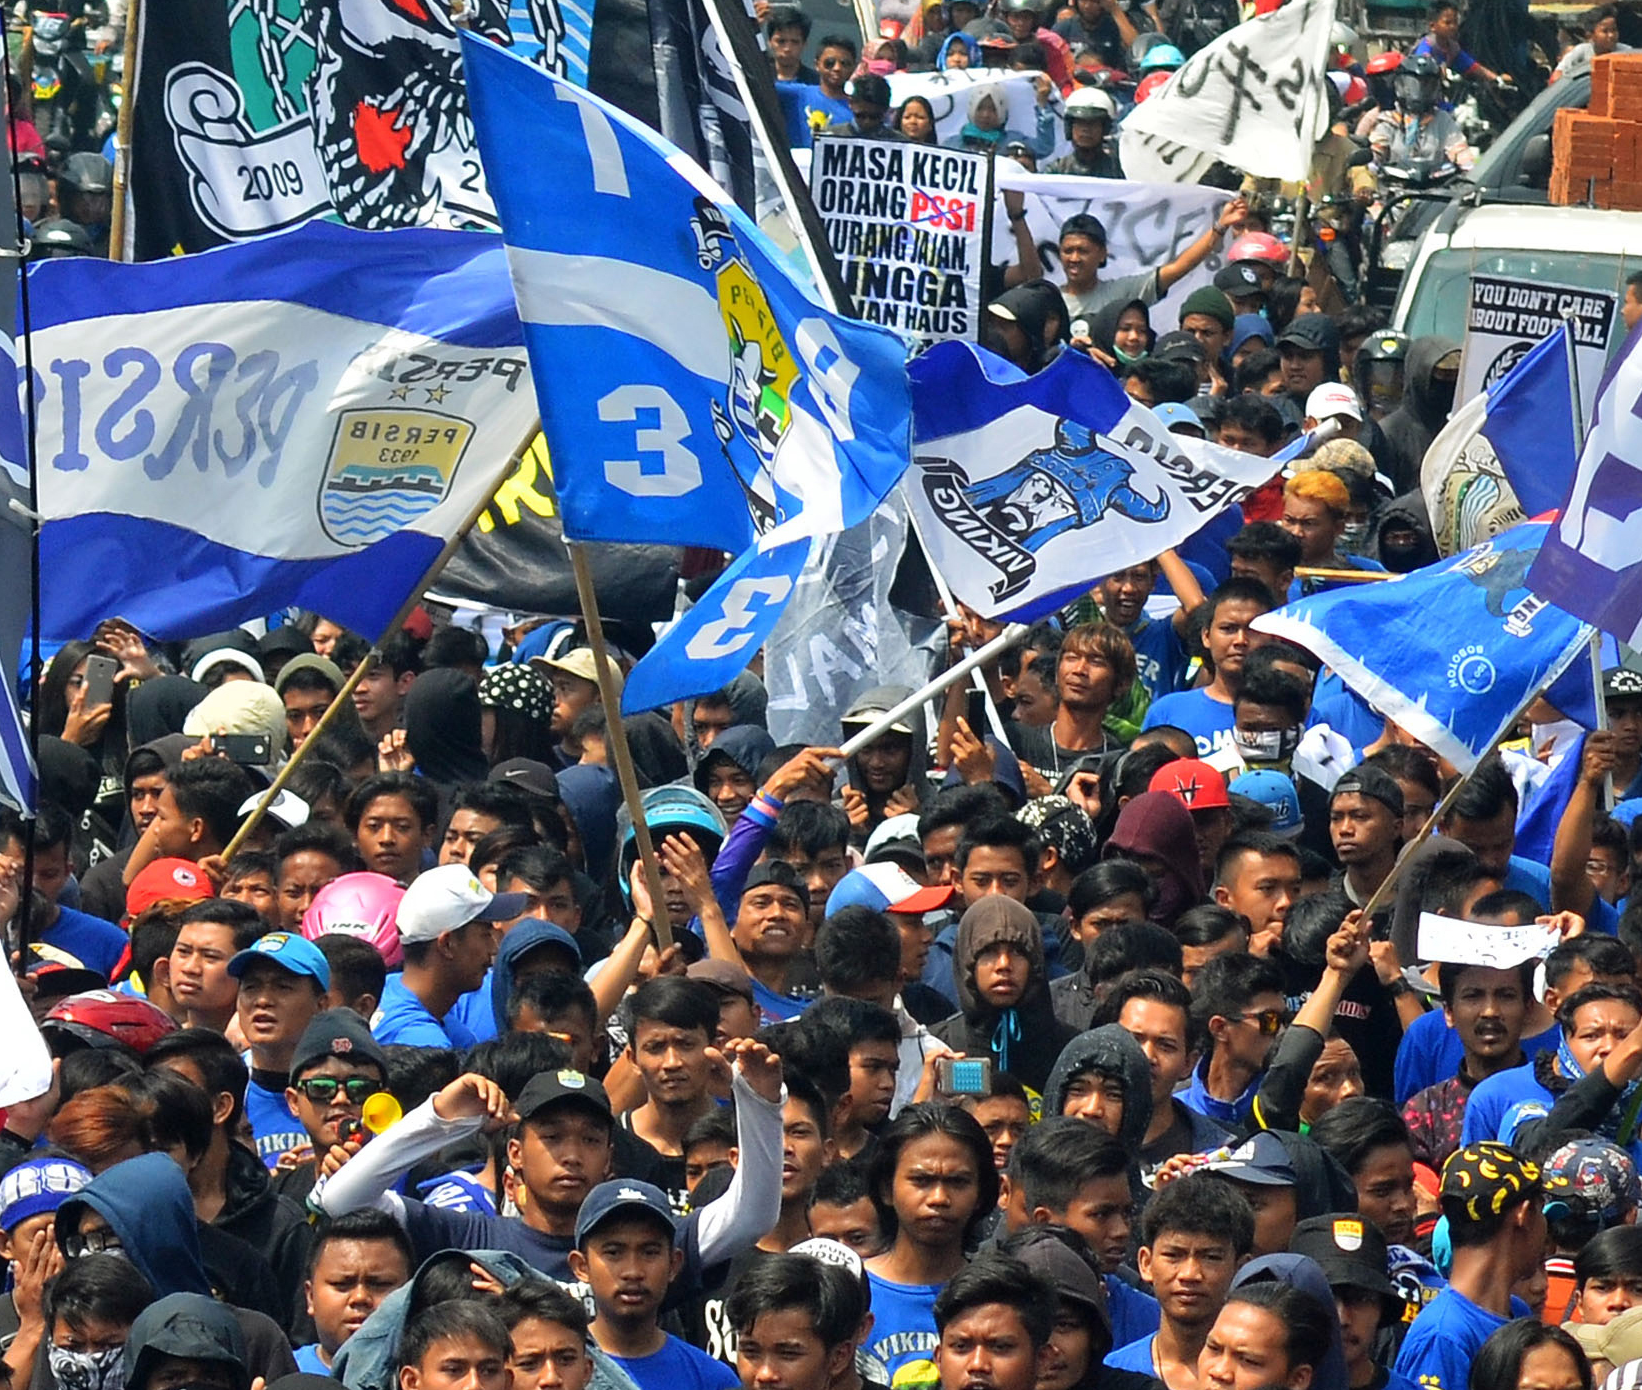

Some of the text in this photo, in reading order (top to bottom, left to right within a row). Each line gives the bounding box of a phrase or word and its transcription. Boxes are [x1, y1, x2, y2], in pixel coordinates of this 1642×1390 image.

[237, 161, 303, 202] 2009
[823, 143, 978, 195] MASA KECIL
[821, 179, 906, 220] ORANG
[911, 192, 976, 232] PSSI
[907, 305, 968, 334] HAUS
[1472, 307, 1514, 329] BOUT
[1474, 283, 1606, 321] YOU DON'T CARE
[598, 384, 704, 498] 3
